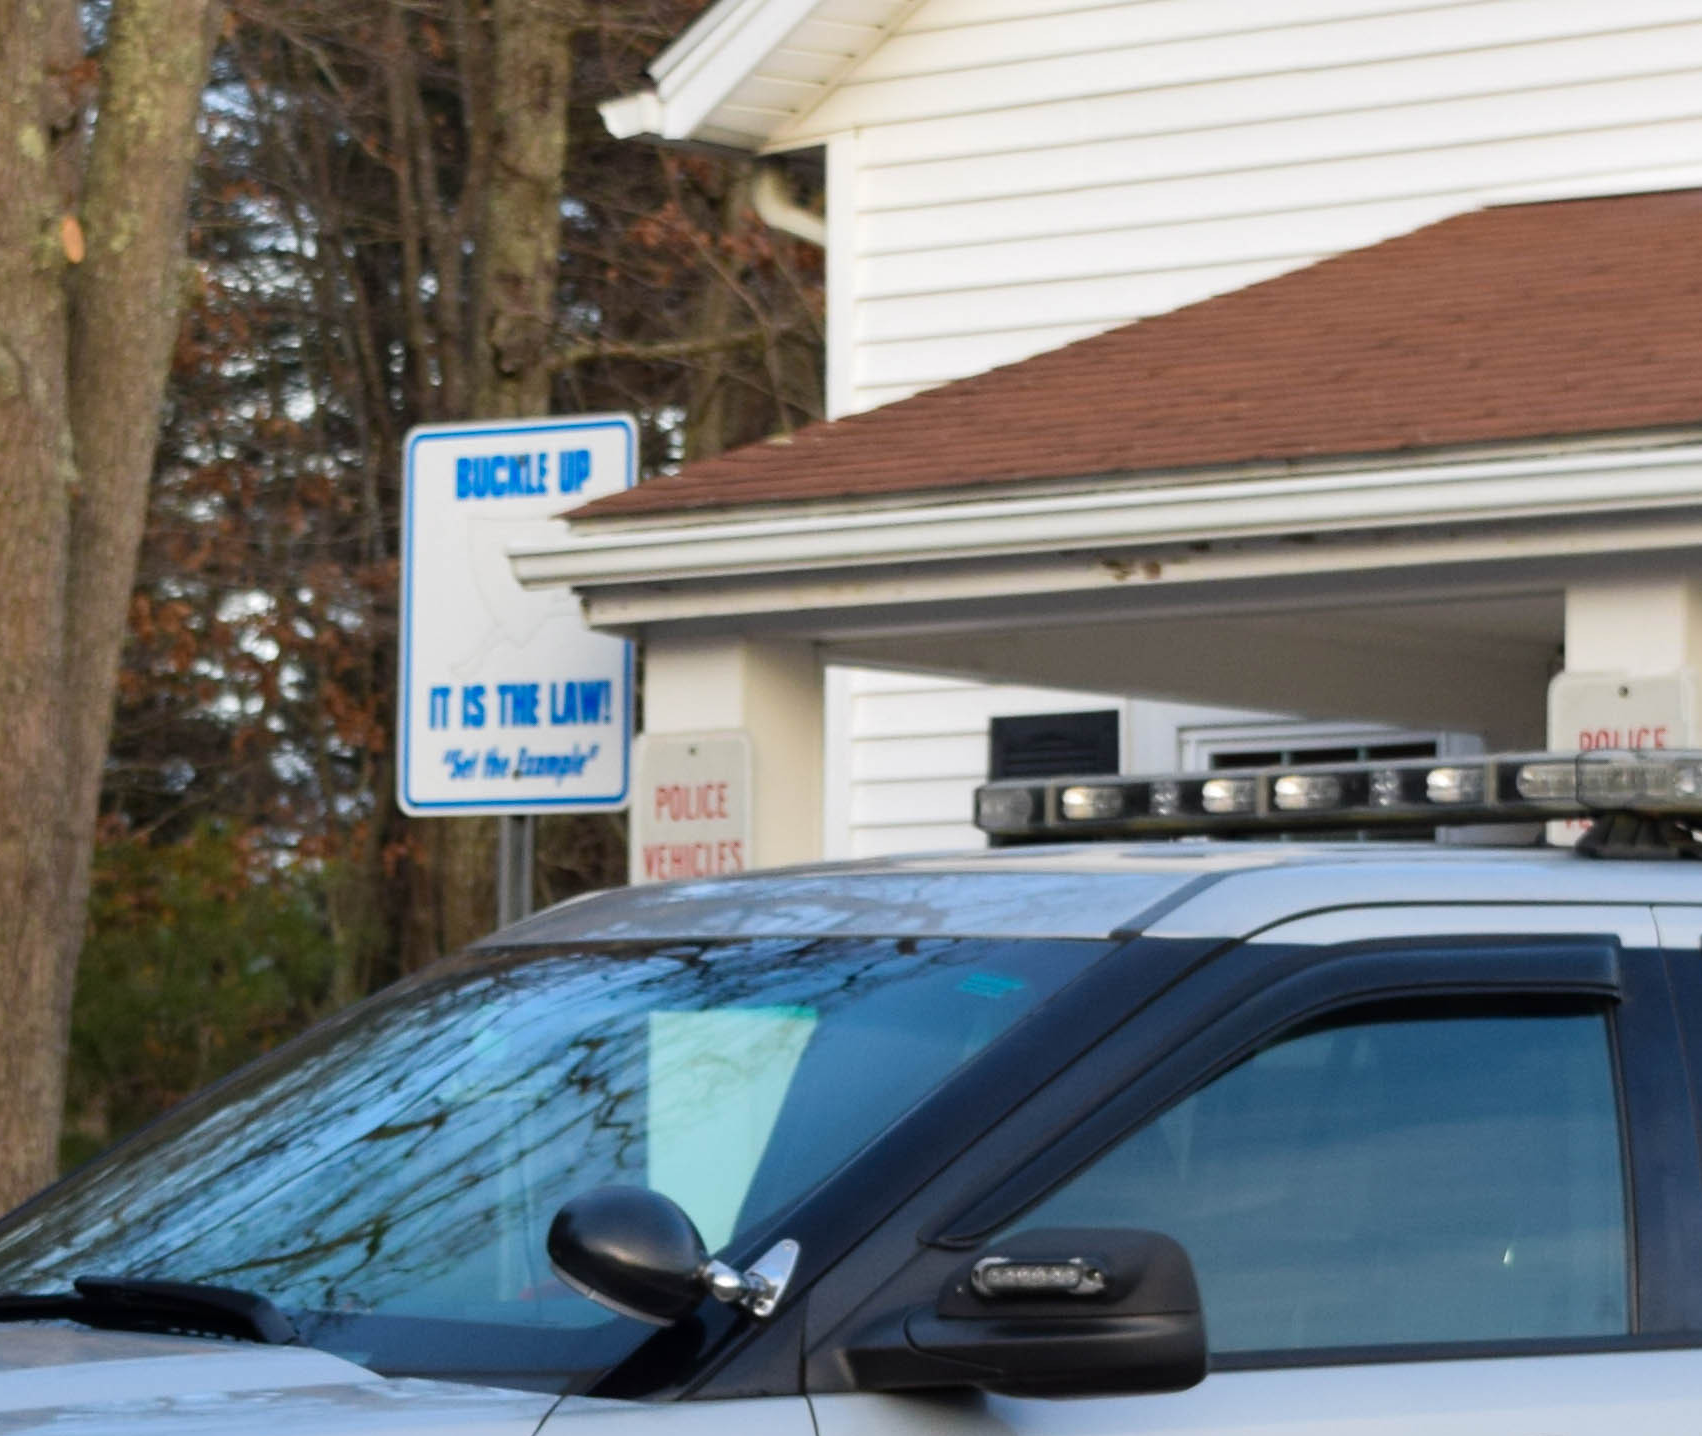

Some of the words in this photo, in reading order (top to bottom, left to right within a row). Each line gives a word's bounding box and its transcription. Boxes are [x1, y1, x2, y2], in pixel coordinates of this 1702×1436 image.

[456, 452, 547, 499] BUCKLE
[559, 449, 590, 494] UP
[429, 686, 451, 730] IT
[462, 684, 486, 728] IS
[496, 682, 540, 728] THE
[550, 679, 612, 726] LAW!
[1579, 727, 1668, 751] POLICE
[482, 745, 510, 780] the
[654, 782, 729, 822] POLICE
[642, 841, 744, 880] VEHICLES
